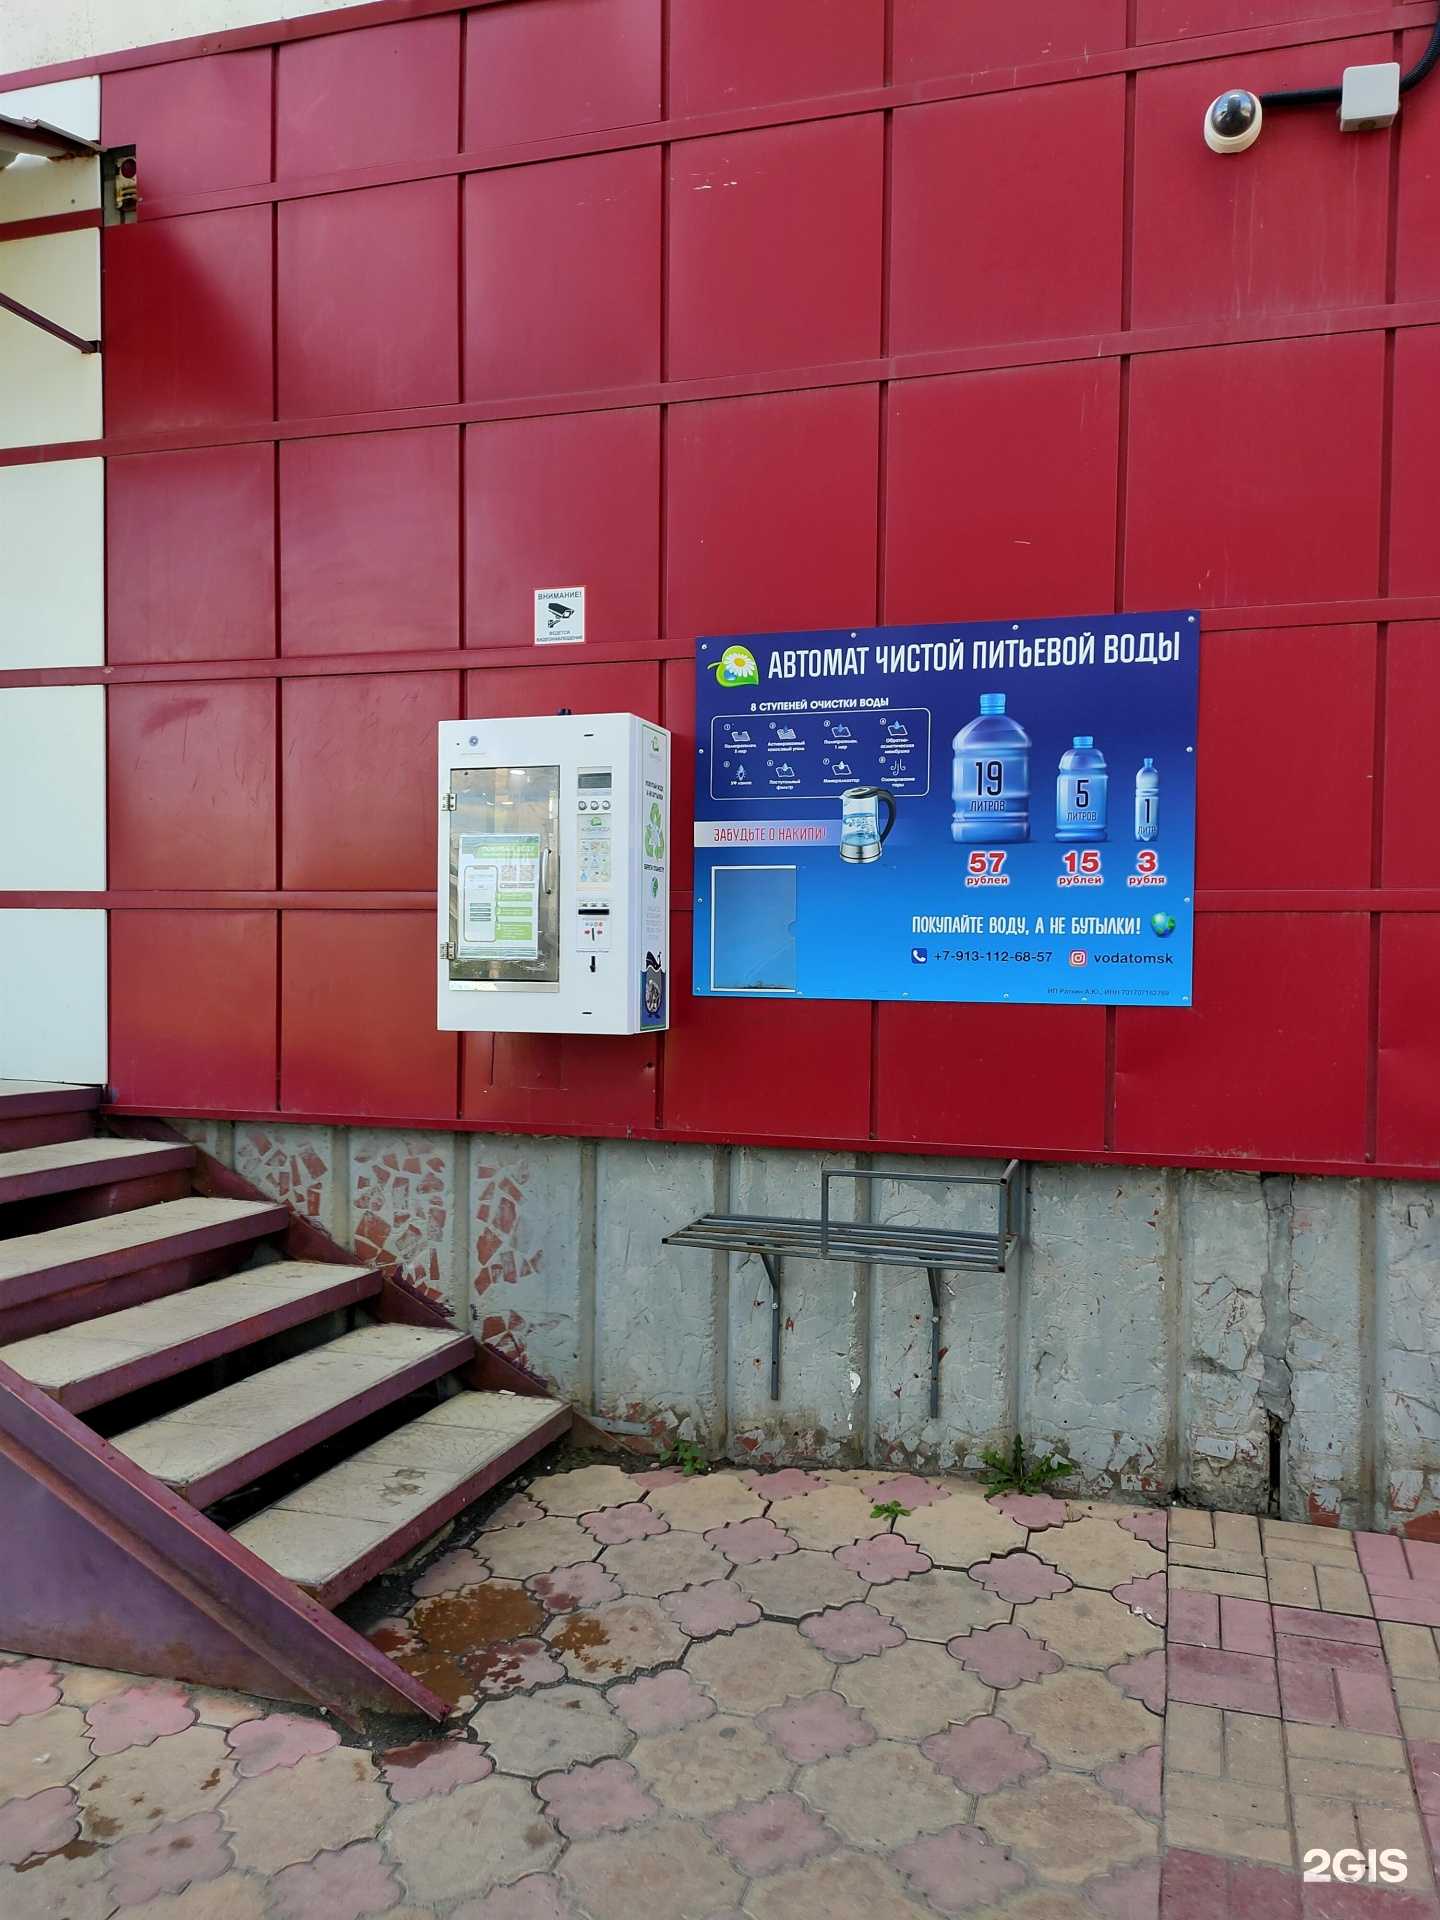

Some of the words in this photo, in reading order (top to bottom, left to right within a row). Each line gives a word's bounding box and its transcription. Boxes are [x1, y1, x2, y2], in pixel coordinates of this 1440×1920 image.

[537, 591, 582, 600] ВНИМАНИЕ!
[768, 647, 869, 679] АВТОМАТ
[875, 638, 964, 674] ЧИСТОЙ
[972, 632, 1095, 669] ПИТЬЕВОЙ
[1104, 631, 1181, 664] ВОДЫ
[750, 703, 757, 712] 8
[759, 699, 808, 712] СТУПЕНЕЙ
[810, 699, 857, 710] ОЧИСТКИ
[859, 697, 889, 708] ВОДЫ
[975, 761, 1002, 796] 19
[1076, 779, 1089, 808] 5
[970, 800, 1005, 812] ЛИТРОВ
[1144, 798, 1150, 824] 1
[1067, 811, 1097, 822] ЛИТРОВ
[714, 827, 766, 842] ЗАБУДЬТЕ
[768, 827, 775, 841] О
[778, 826, 826, 841] НАКИПИ!
[969, 852, 1006, 873] 57
[1064, 852, 1100, 873] 15
[1137, 852, 1157, 873] 3
[966, 875, 1009, 886] рублей
[1058, 875, 1102, 886] рублей
[1128, 875, 1165, 886] рубля
[912, 915, 984, 934] ПОКУПАЙТЕ
[989, 916, 1029, 936] ВОДУ,
[1035, 917, 1045, 934] А
[1050, 917, 1065, 935] НЕ
[1071, 917, 1141, 935] БУТЫЛКИ!
[934, 950, 1053, 962] +7-913-112-68-57
[1094, 952, 1174, 964] vodatomsk
